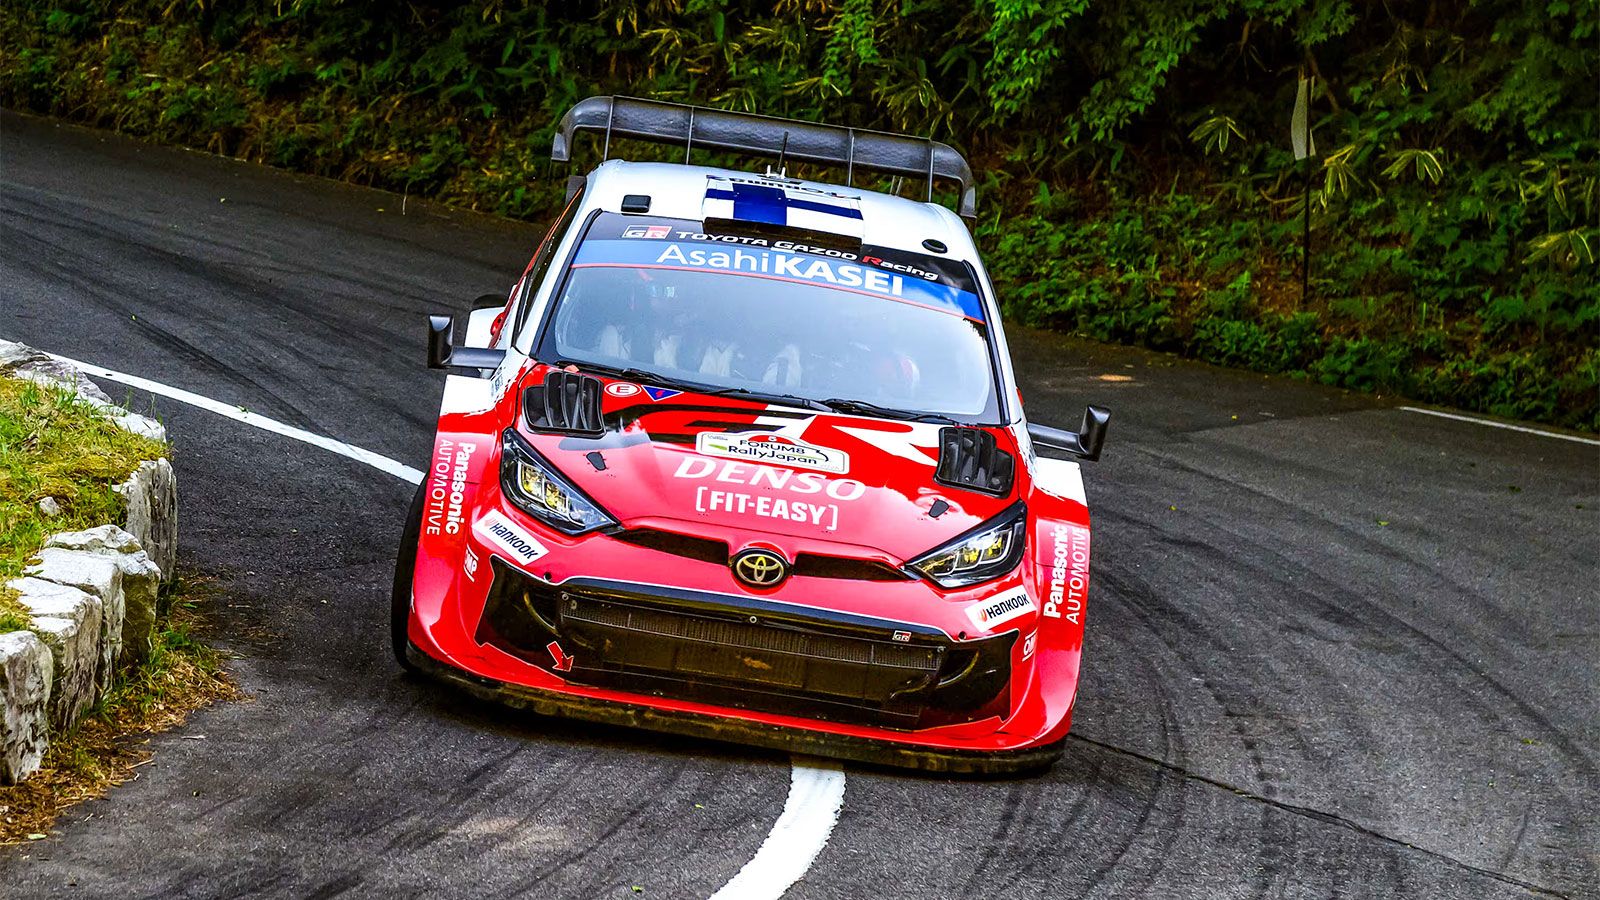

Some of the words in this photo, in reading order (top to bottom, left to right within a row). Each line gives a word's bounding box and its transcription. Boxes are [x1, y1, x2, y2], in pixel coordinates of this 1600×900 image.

[622, 226, 671, 239] GR
[676, 231, 768, 246] TOYOTA
[771, 240, 858, 261] GAZOO
[861, 255, 939, 281] Racing
[426, 438, 454, 536] AUTOMOTIVE
[445, 441, 477, 535] Panasonic
[673, 455, 868, 502] DENSO
[739, 439, 806, 455] FORUM8
[1043, 524, 1069, 619] Panasonic
[1066, 527, 1090, 625] AUTOMOTIVE
